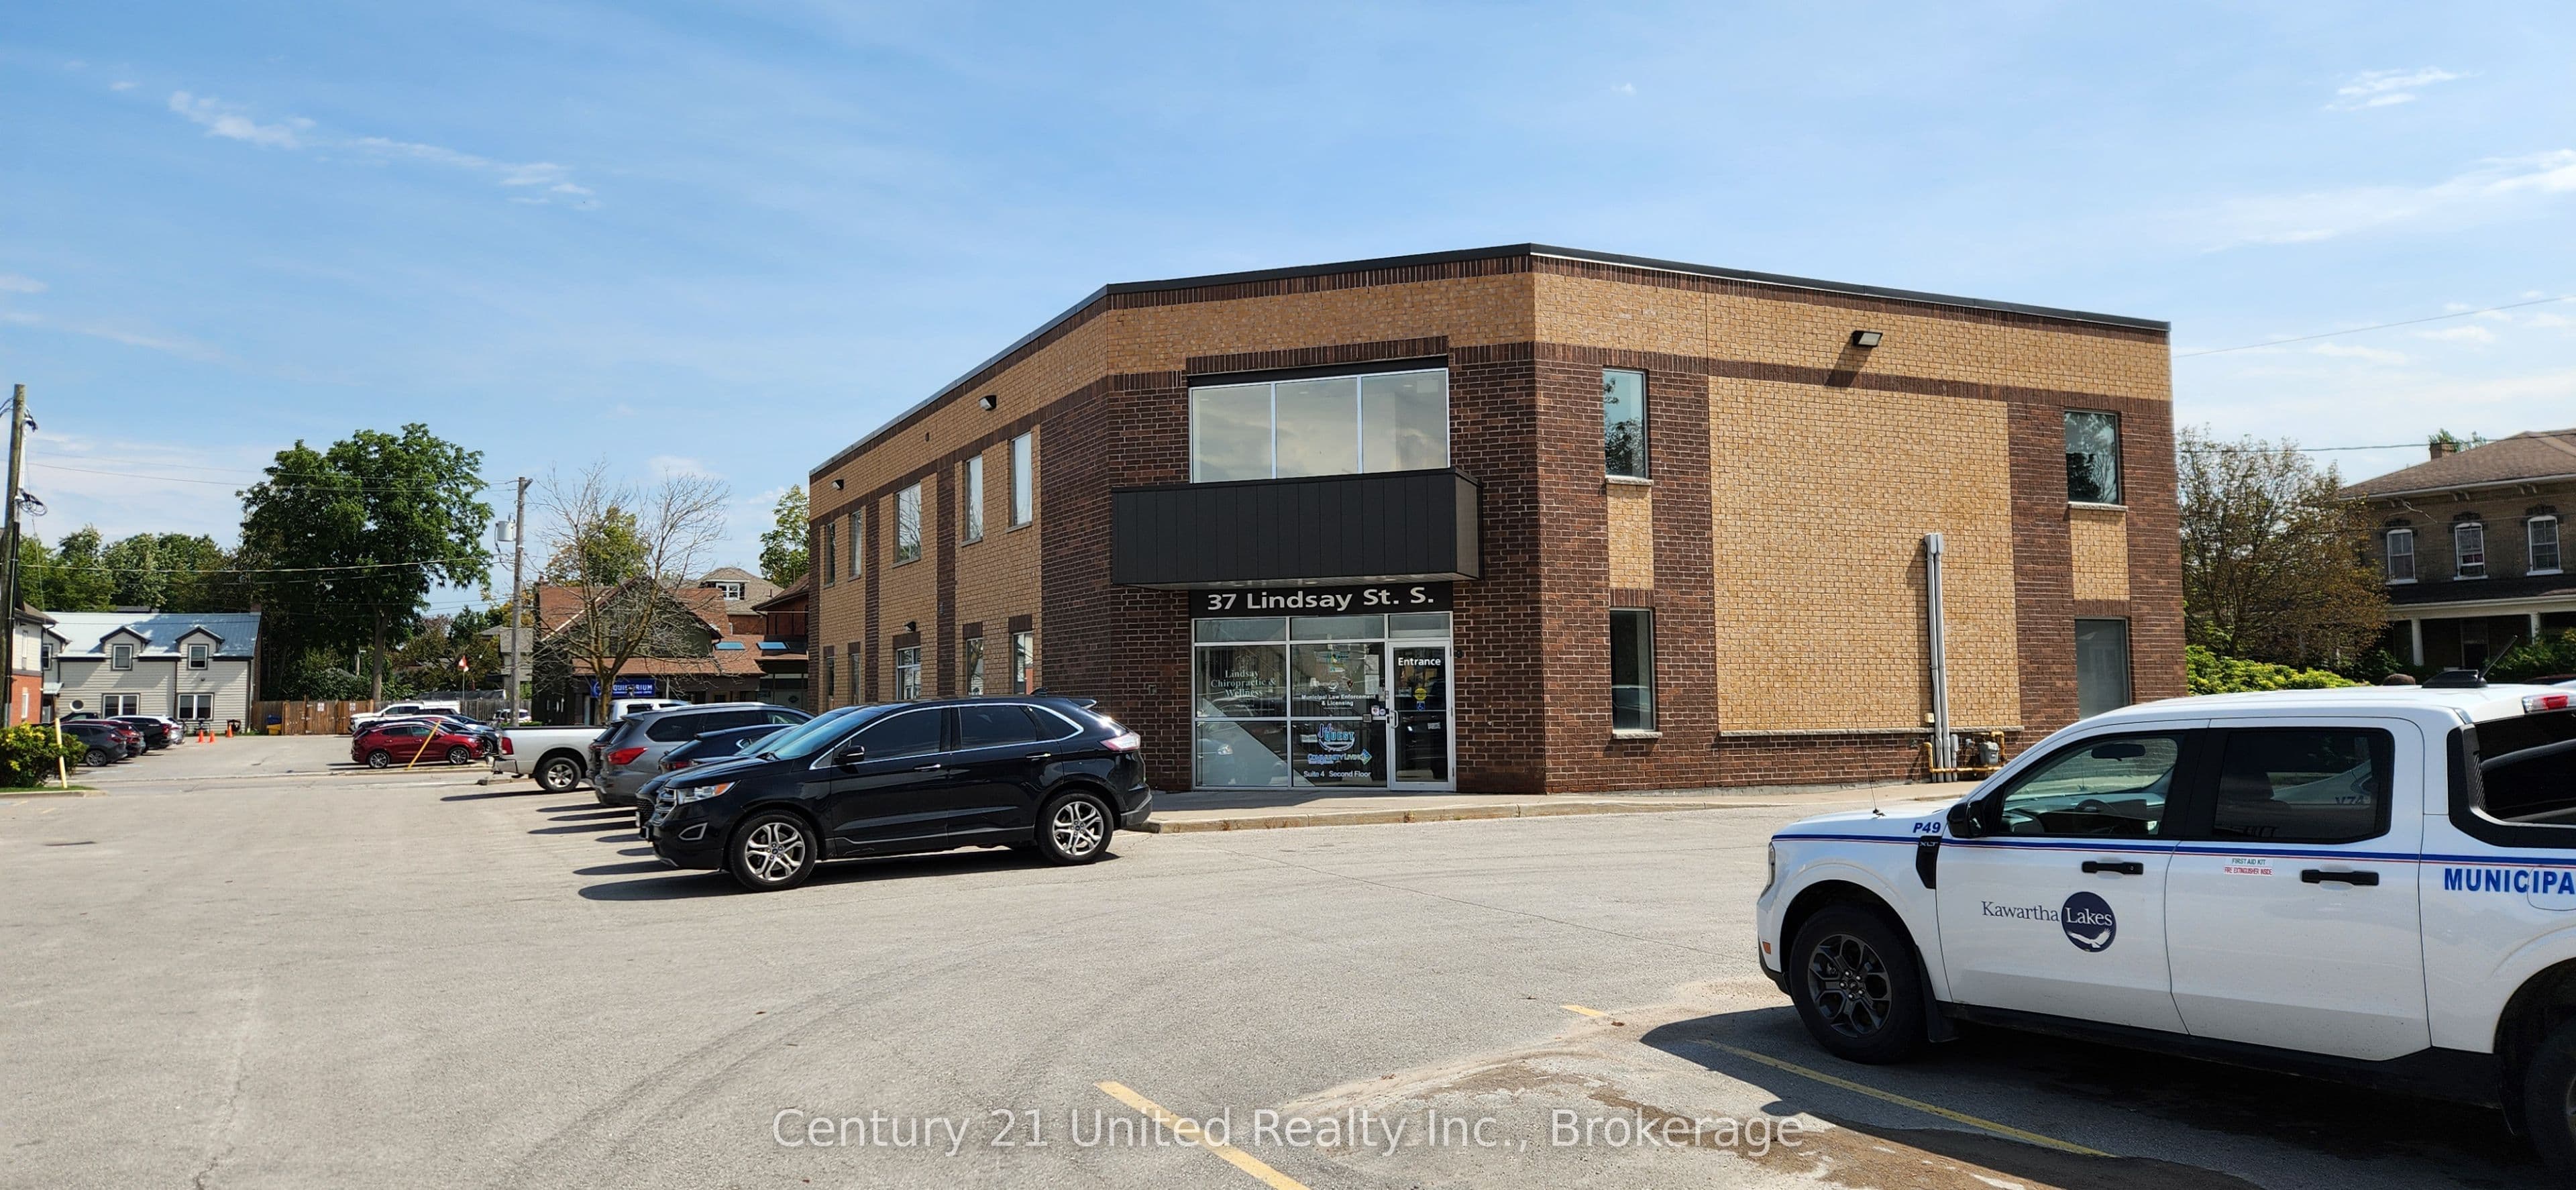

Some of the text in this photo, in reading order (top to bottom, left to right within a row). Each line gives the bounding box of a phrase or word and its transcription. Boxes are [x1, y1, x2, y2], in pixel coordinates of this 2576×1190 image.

[1208, 586, 1434, 611] 37 Lindsay St. S.
[1398, 657, 1441, 666] Entrance
[1225, 670, 1259, 679] Lindsay
[1210, 677, 1277, 688] Chiropractic &
[1224, 688, 1263, 698] Wellness
[1324, 731, 1355, 742] QUEST
[1913, 822, 1941, 833] P49
[1981, 900, 2112, 926] Kawartha Lakes
